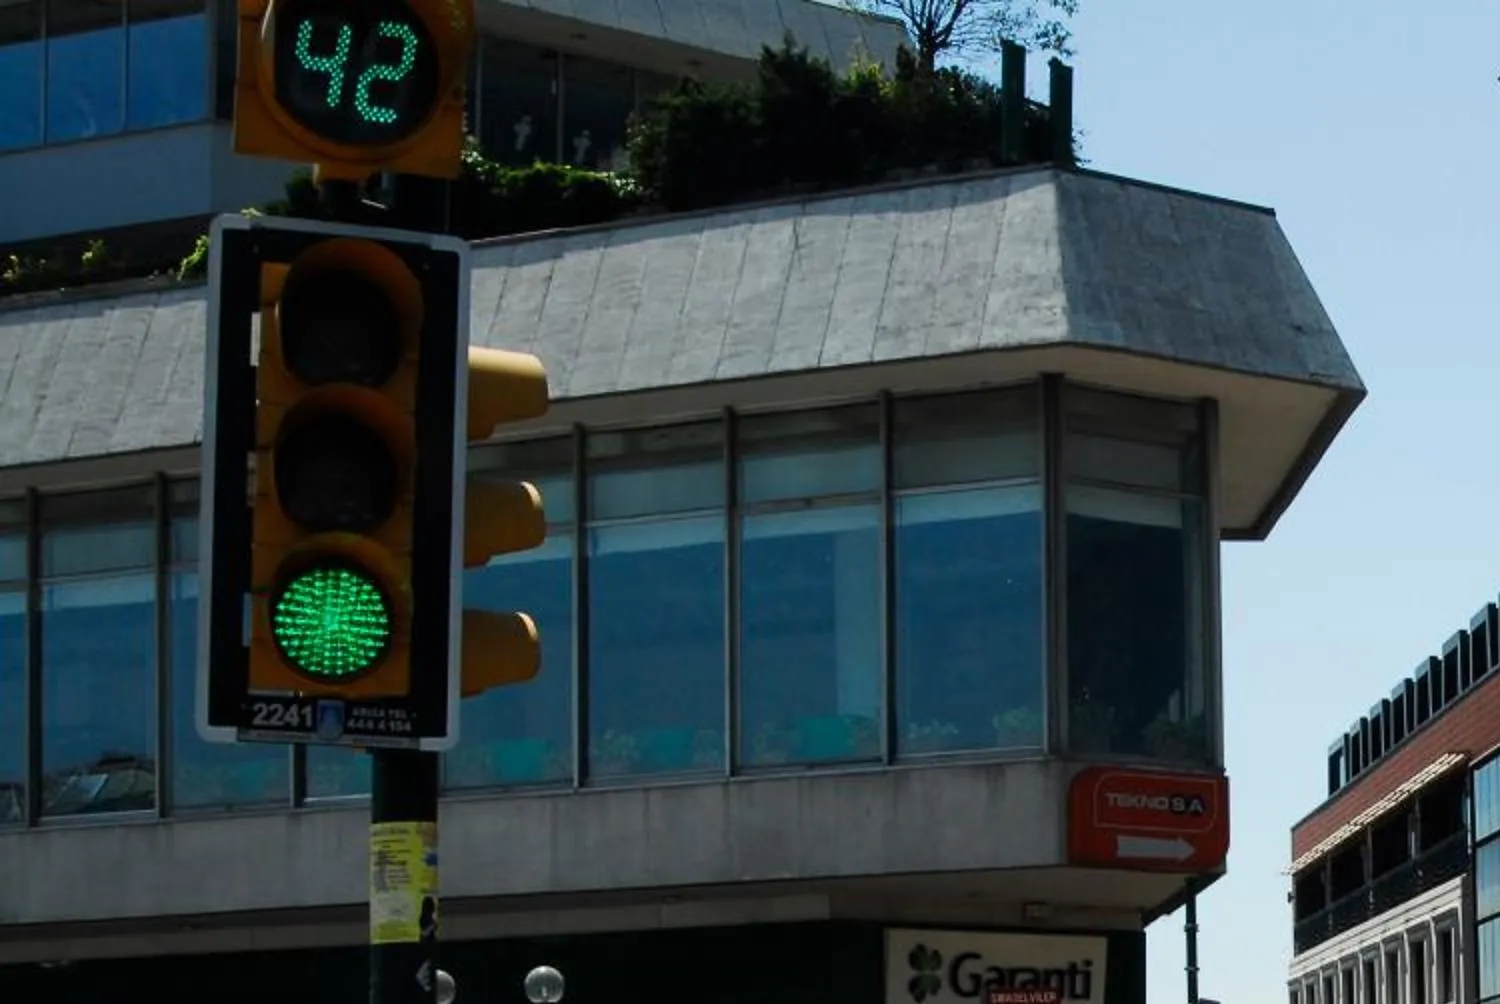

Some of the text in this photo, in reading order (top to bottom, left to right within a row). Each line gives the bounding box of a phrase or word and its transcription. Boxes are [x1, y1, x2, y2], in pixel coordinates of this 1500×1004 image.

[295, 20, 418, 123] 42
[252, 702, 313, 728] 2241
[1104, 792, 1204, 814] TEKNOSA
[948, 953, 1093, 1000] Garanti
